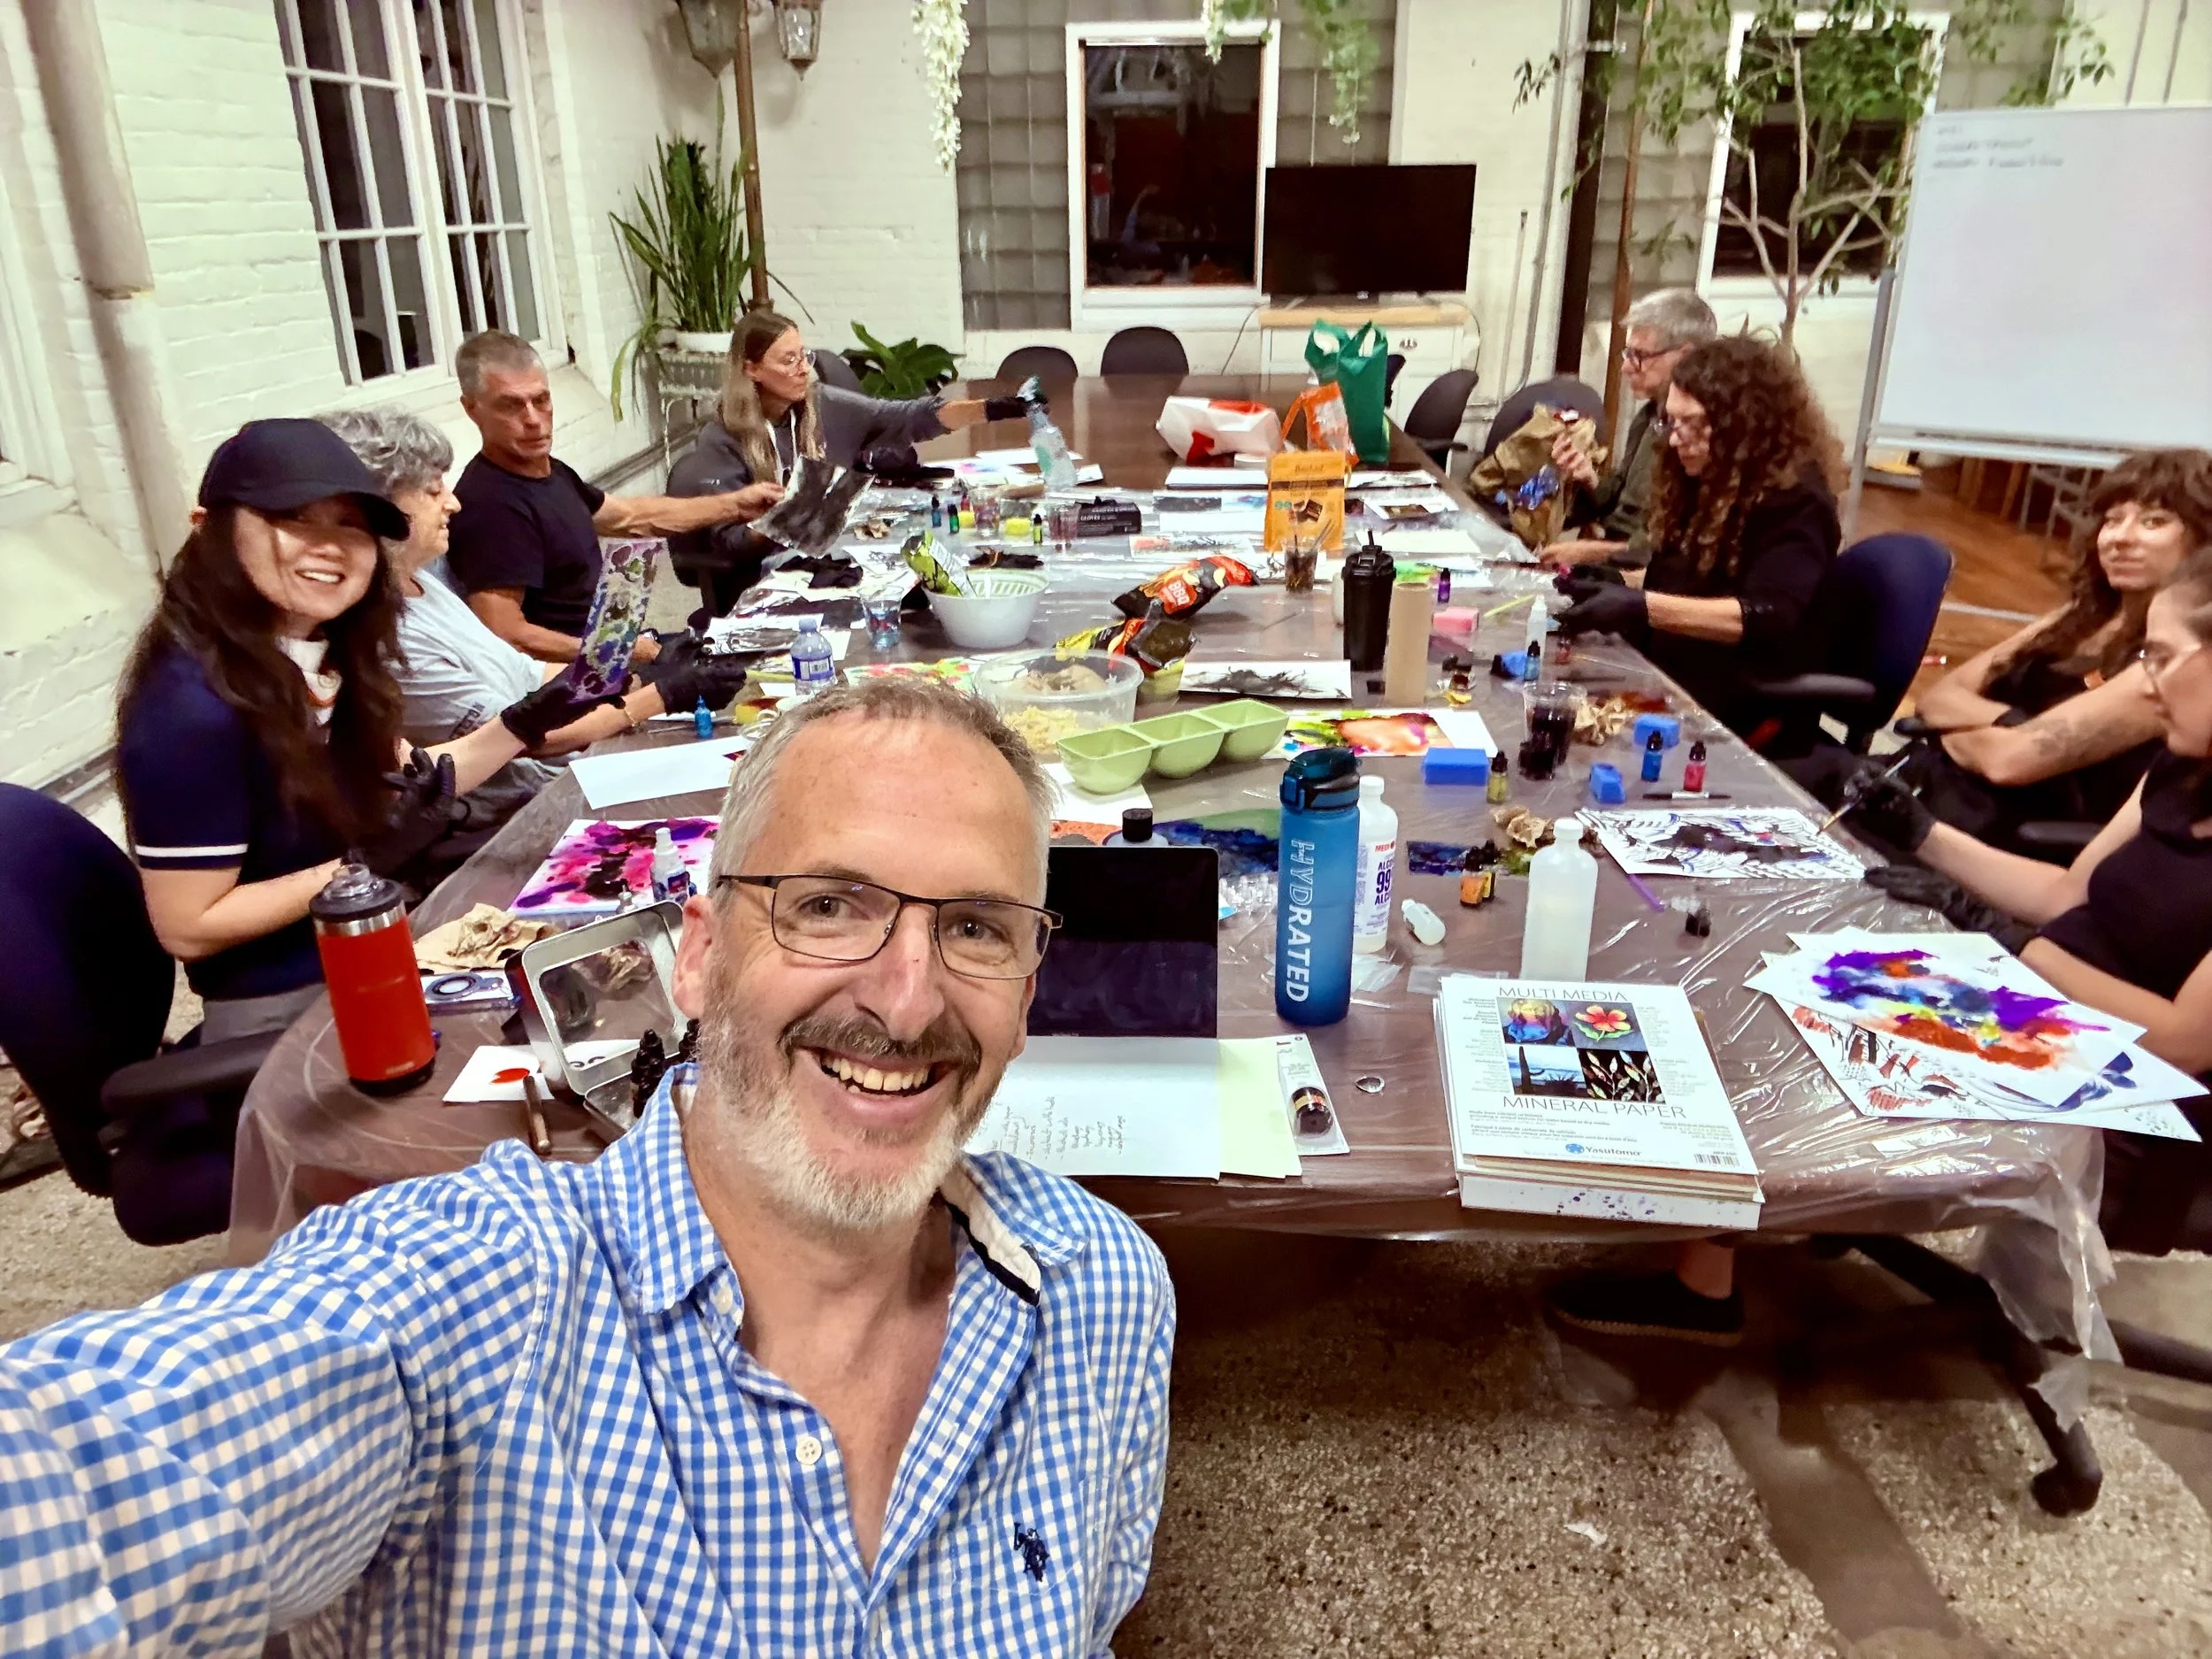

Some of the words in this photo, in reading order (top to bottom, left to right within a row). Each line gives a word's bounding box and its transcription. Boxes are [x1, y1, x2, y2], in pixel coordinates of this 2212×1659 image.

[1286, 840, 1315, 1002] HYDRATED
[1499, 986, 1556, 999] MULTI
[1563, 989, 1628, 1002] MEDIA
[1503, 1095, 1609, 1115] MINERAL
[1614, 1102, 1686, 1119] PAPER
[1585, 1145, 1640, 1156] Yasutomo
